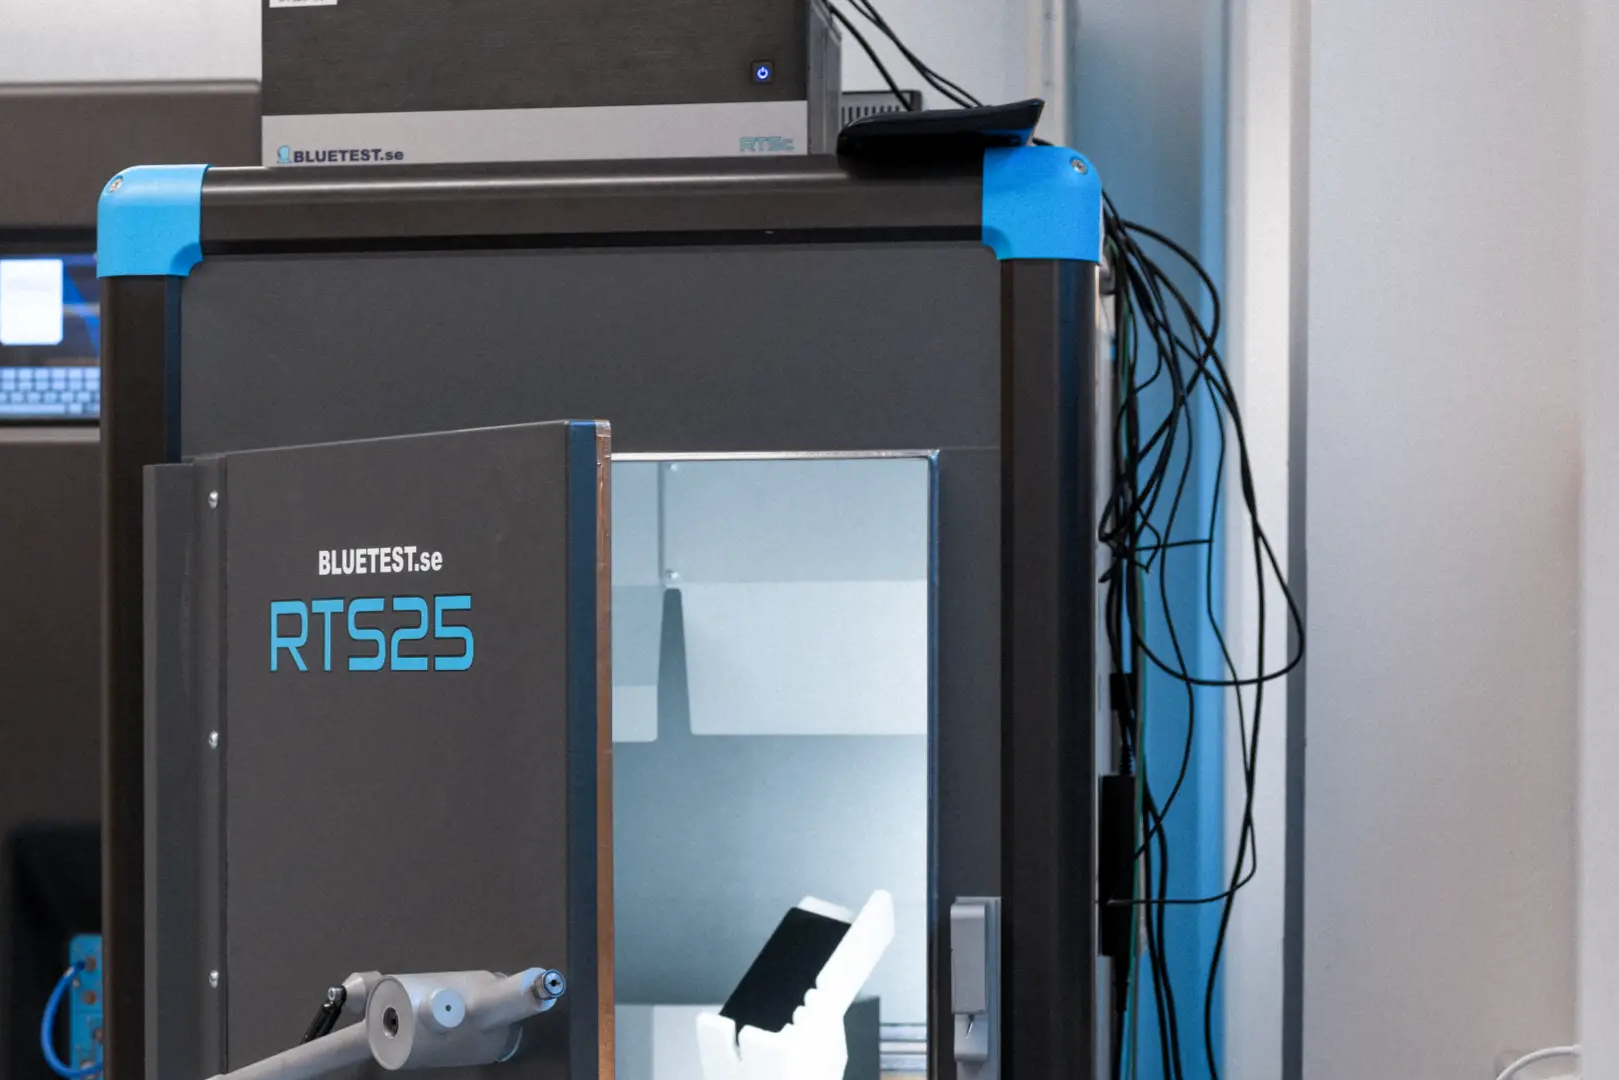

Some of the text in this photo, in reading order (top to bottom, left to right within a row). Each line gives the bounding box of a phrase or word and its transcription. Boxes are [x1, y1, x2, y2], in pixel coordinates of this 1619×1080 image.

[293, 149, 405, 163] BLUETEST.se
[318, 545, 444, 576] BLUETEST.se
[269, 594, 475, 672] RTS25
